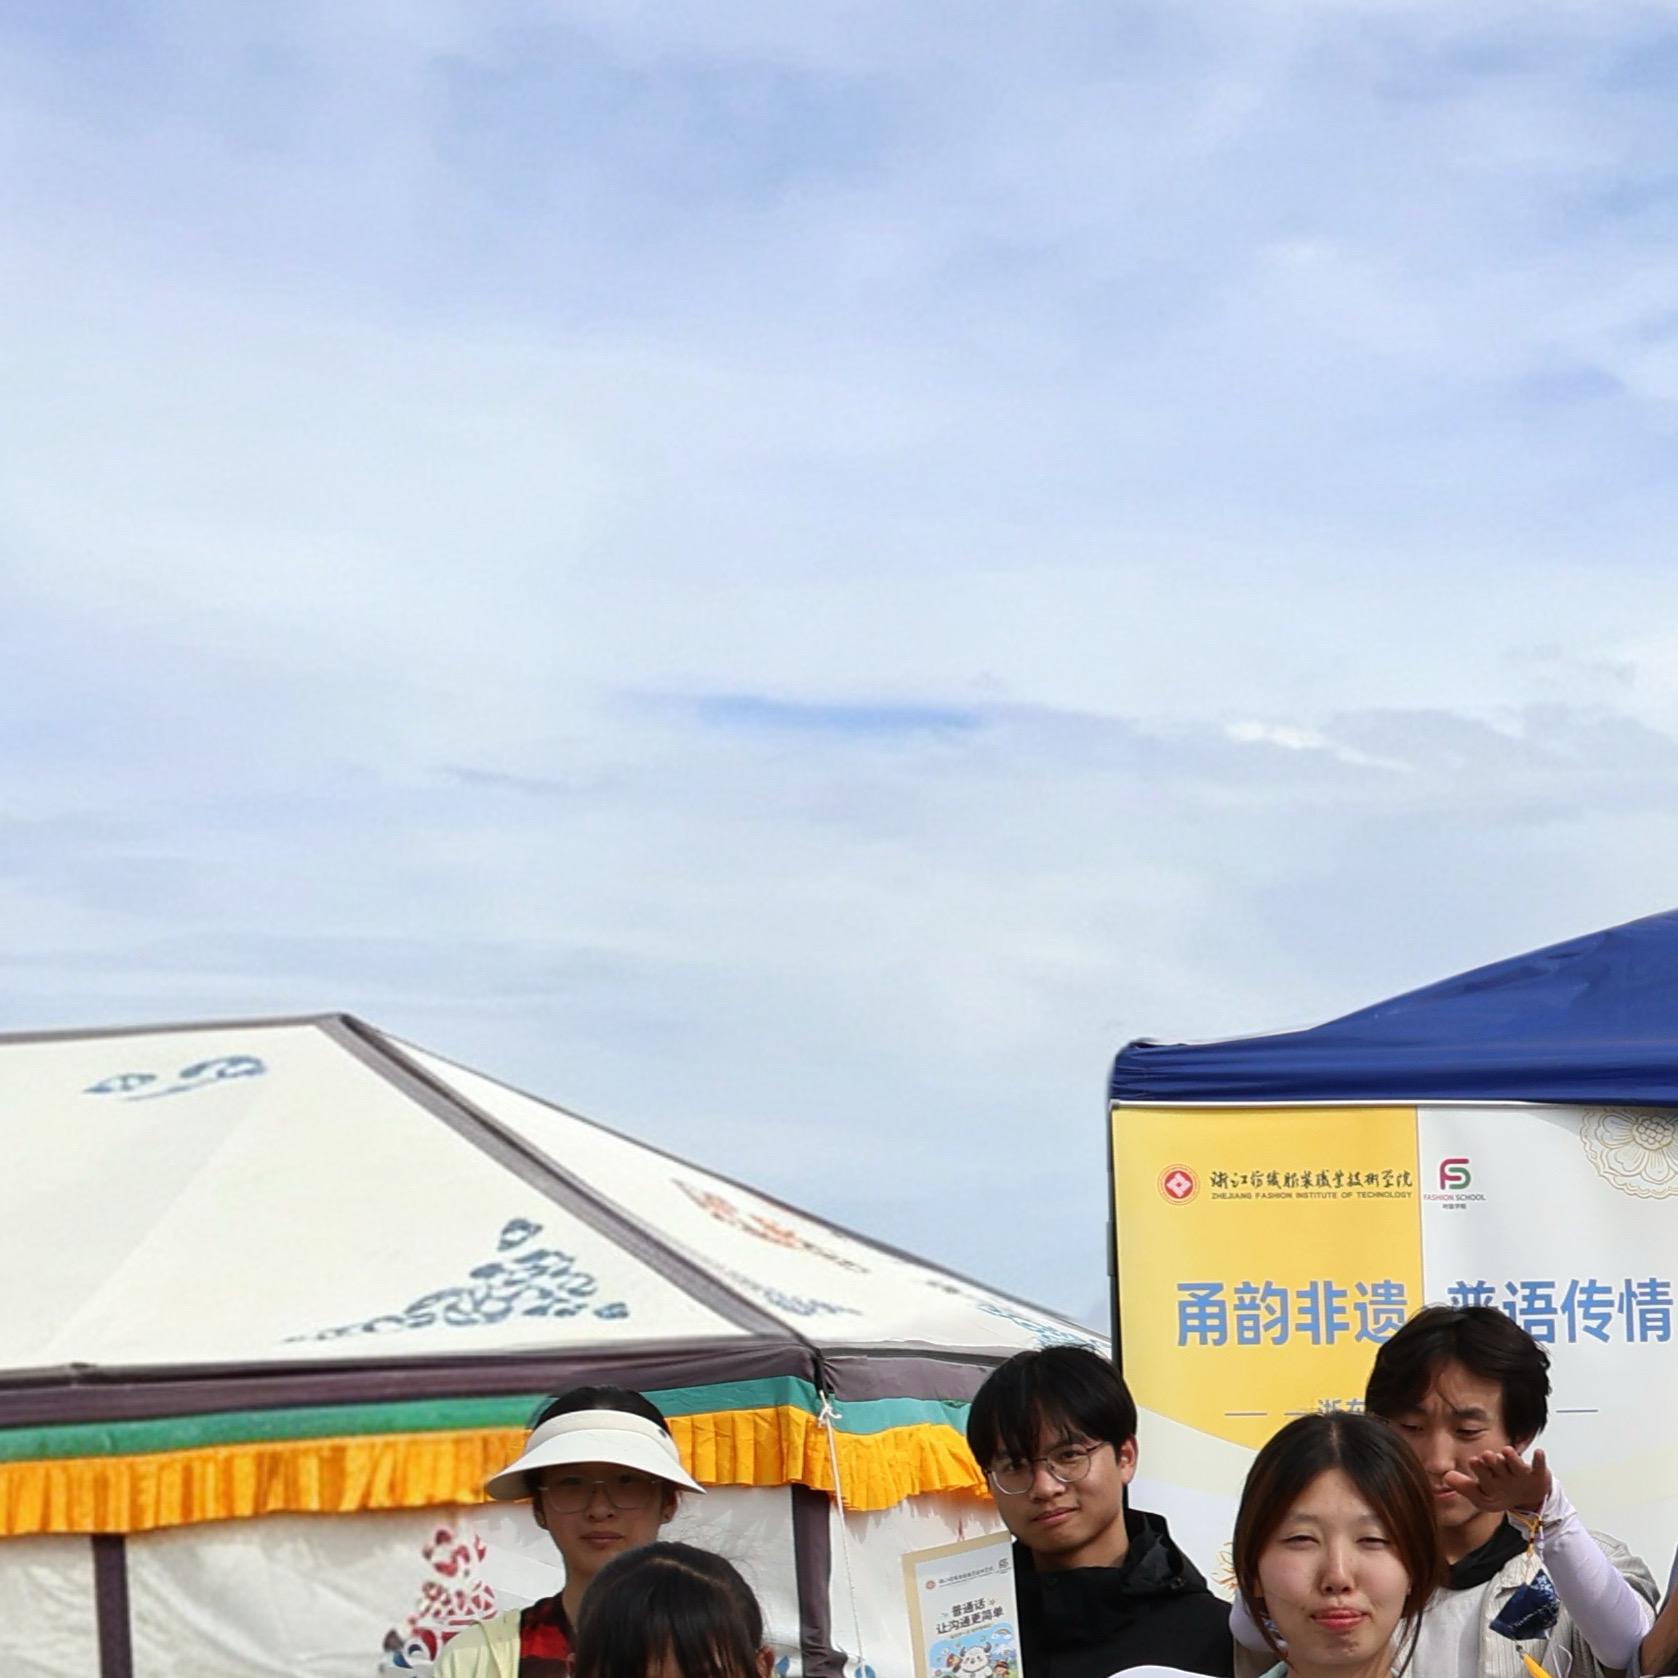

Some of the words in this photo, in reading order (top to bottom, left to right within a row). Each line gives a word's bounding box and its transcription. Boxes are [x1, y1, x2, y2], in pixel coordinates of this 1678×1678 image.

[1211, 1192, 1252, 1200] ZHEJIANG
[1256, 1192, 1293, 1200] FASHION
[1341, 1191, 1352, 1199] OF
[1357, 1191, 1412, 1199] TECHNOLOGY
[1176, 1279, 1405, 1347] 甬韵非遗
[952, 1598, 985, 1617] 普通话
[936, 1606, 1004, 1635] 让沟通更简单
